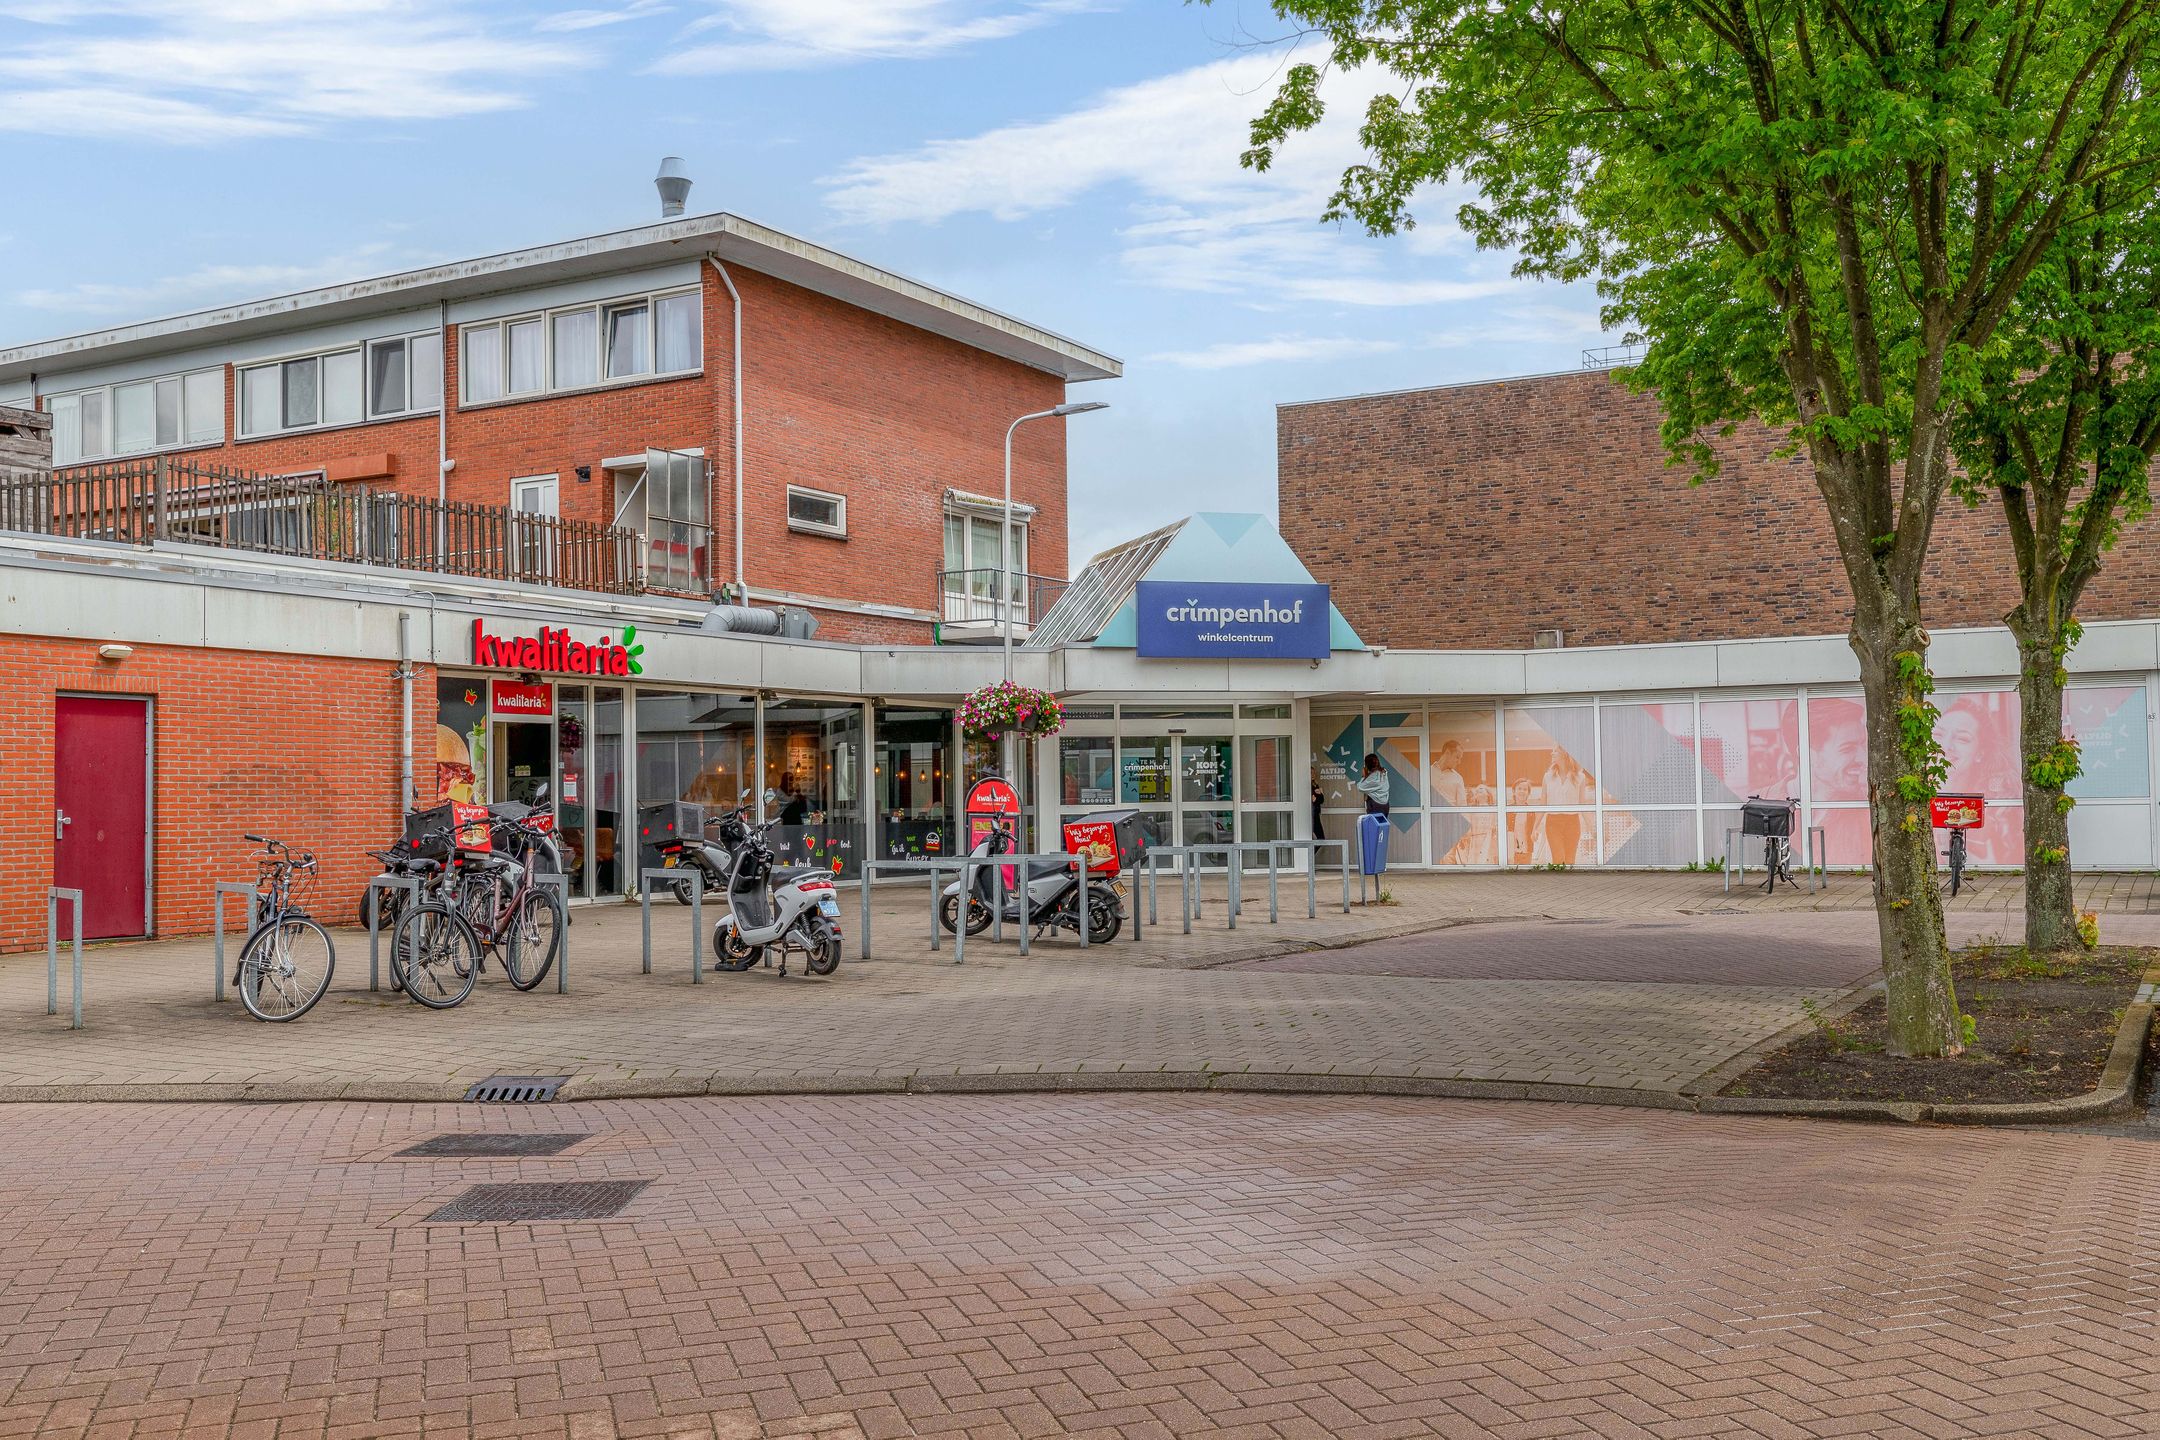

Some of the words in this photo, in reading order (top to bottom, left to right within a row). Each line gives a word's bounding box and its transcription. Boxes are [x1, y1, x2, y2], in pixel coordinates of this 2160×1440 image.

[1166, 598, 1303, 629] crimpenhof
[1197, 632, 1274, 642] winkelcentrum
[473, 617, 629, 677] kwalitaria
[497, 692, 542, 708] kwalitaria
[1124, 762, 1166, 772] crimpenhof
[1196, 761, 1218, 769] KOM
[976, 793, 1008, 802] kwalaria
